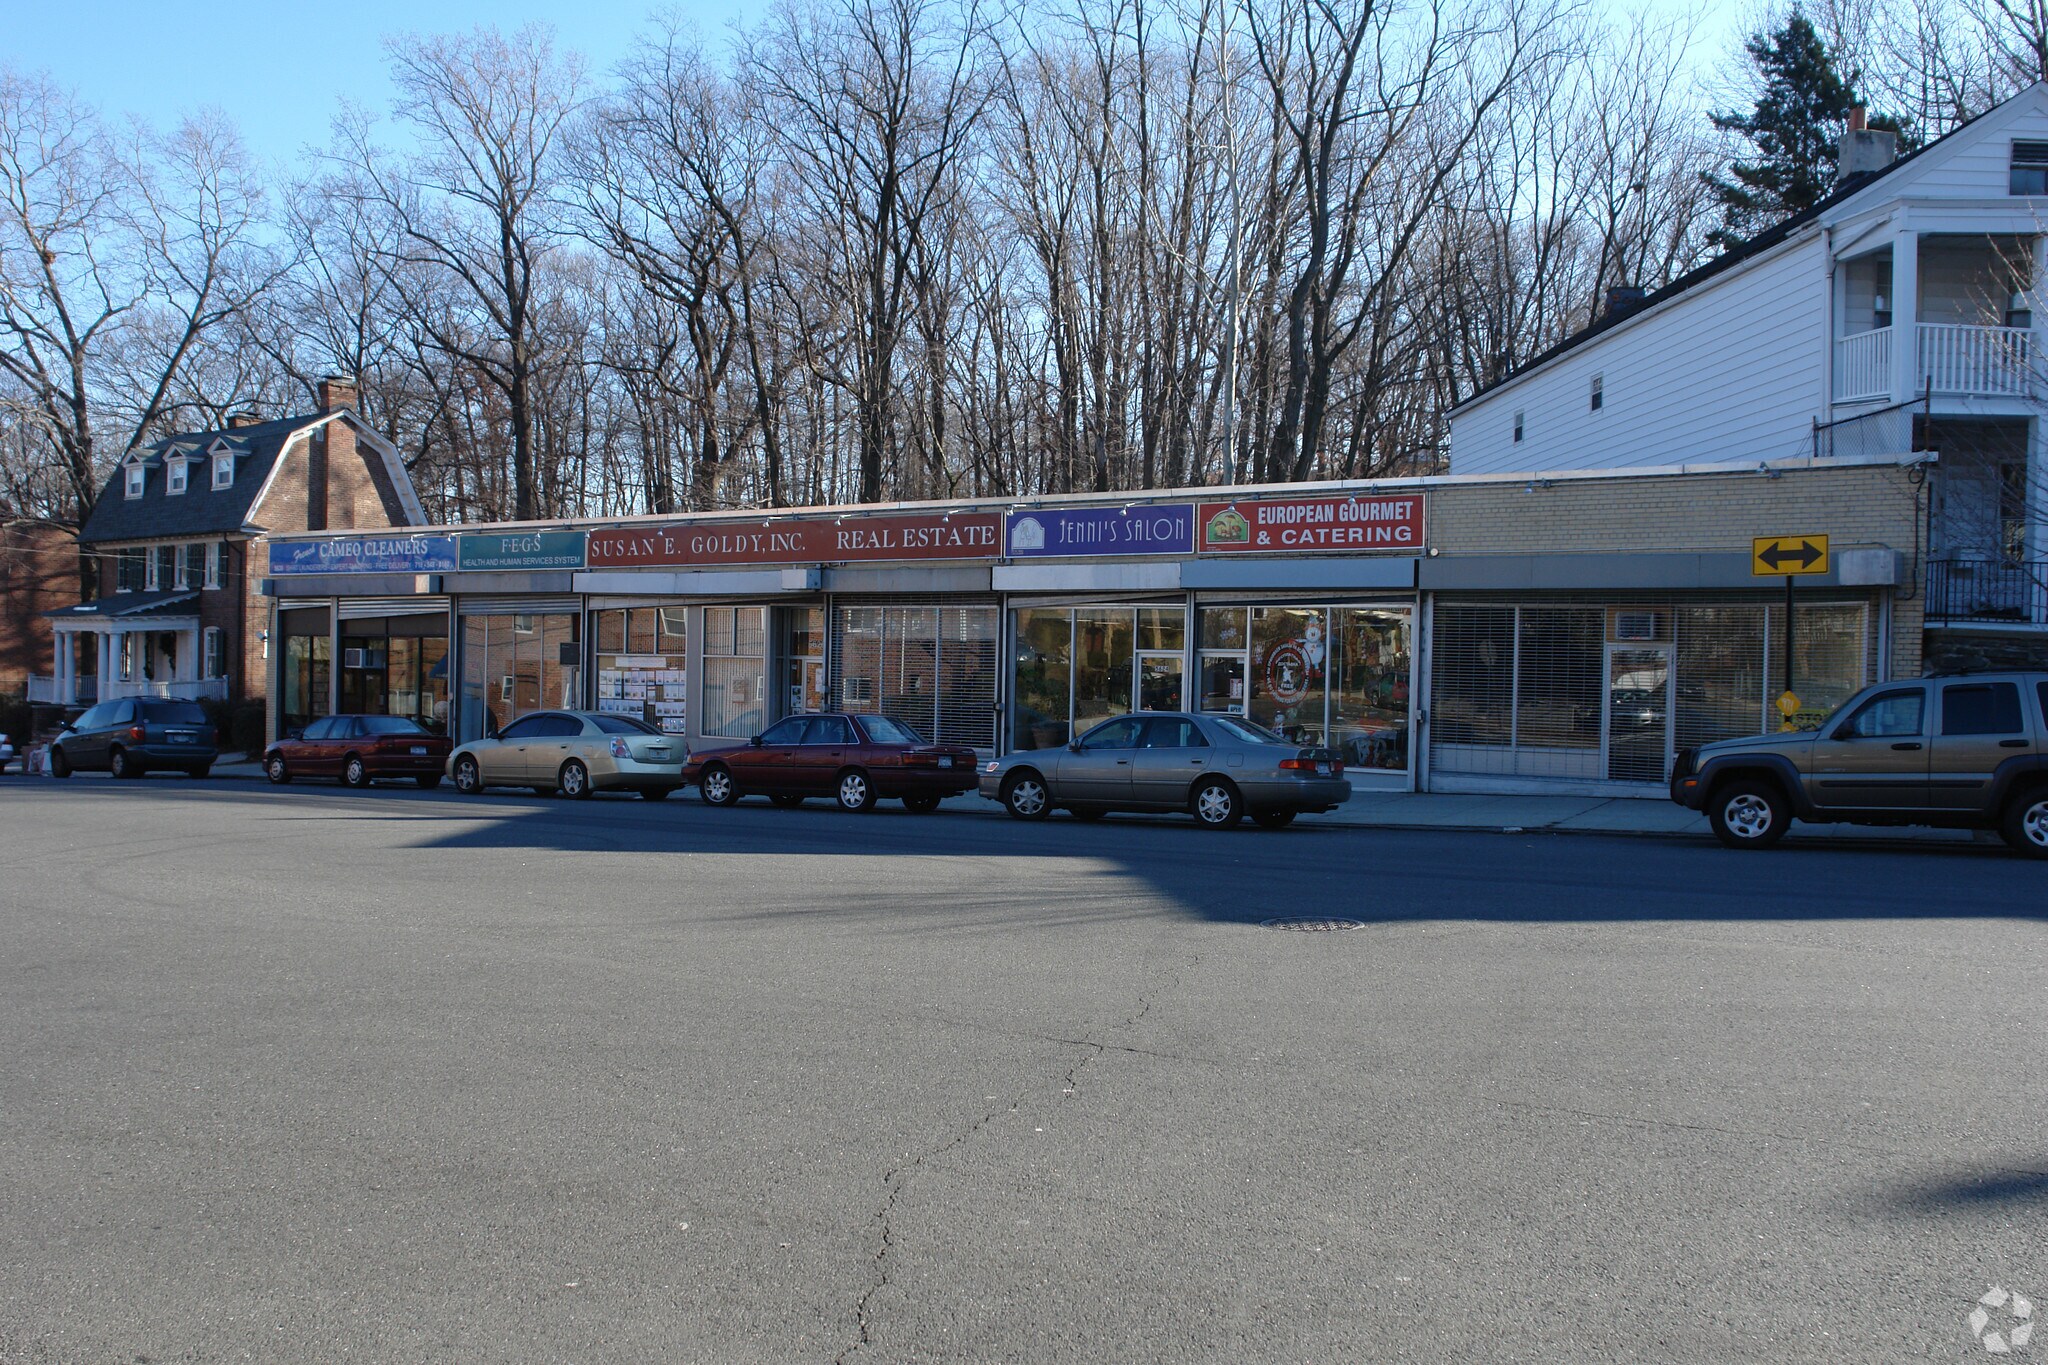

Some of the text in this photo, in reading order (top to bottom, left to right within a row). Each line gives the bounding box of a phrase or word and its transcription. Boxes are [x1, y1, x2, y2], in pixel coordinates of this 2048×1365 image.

[1258, 501, 1413, 524] EUROPEAN GOURMET
[591, 538, 655, 557] SUSAN
[664, 537, 681, 555] E.
[770, 532, 806, 551] INC.
[836, 529, 896, 550] REAL
[902, 525, 996, 547] ESTATE
[1059, 518, 1184, 543] JENNI'S SALON
[1256, 525, 1412, 545] & CATERING
[320, 540, 428, 557] CAMEO CLEANERS
[463, 555, 580, 567] HEALTH AND HUMAN SERVICES SYSTEM
